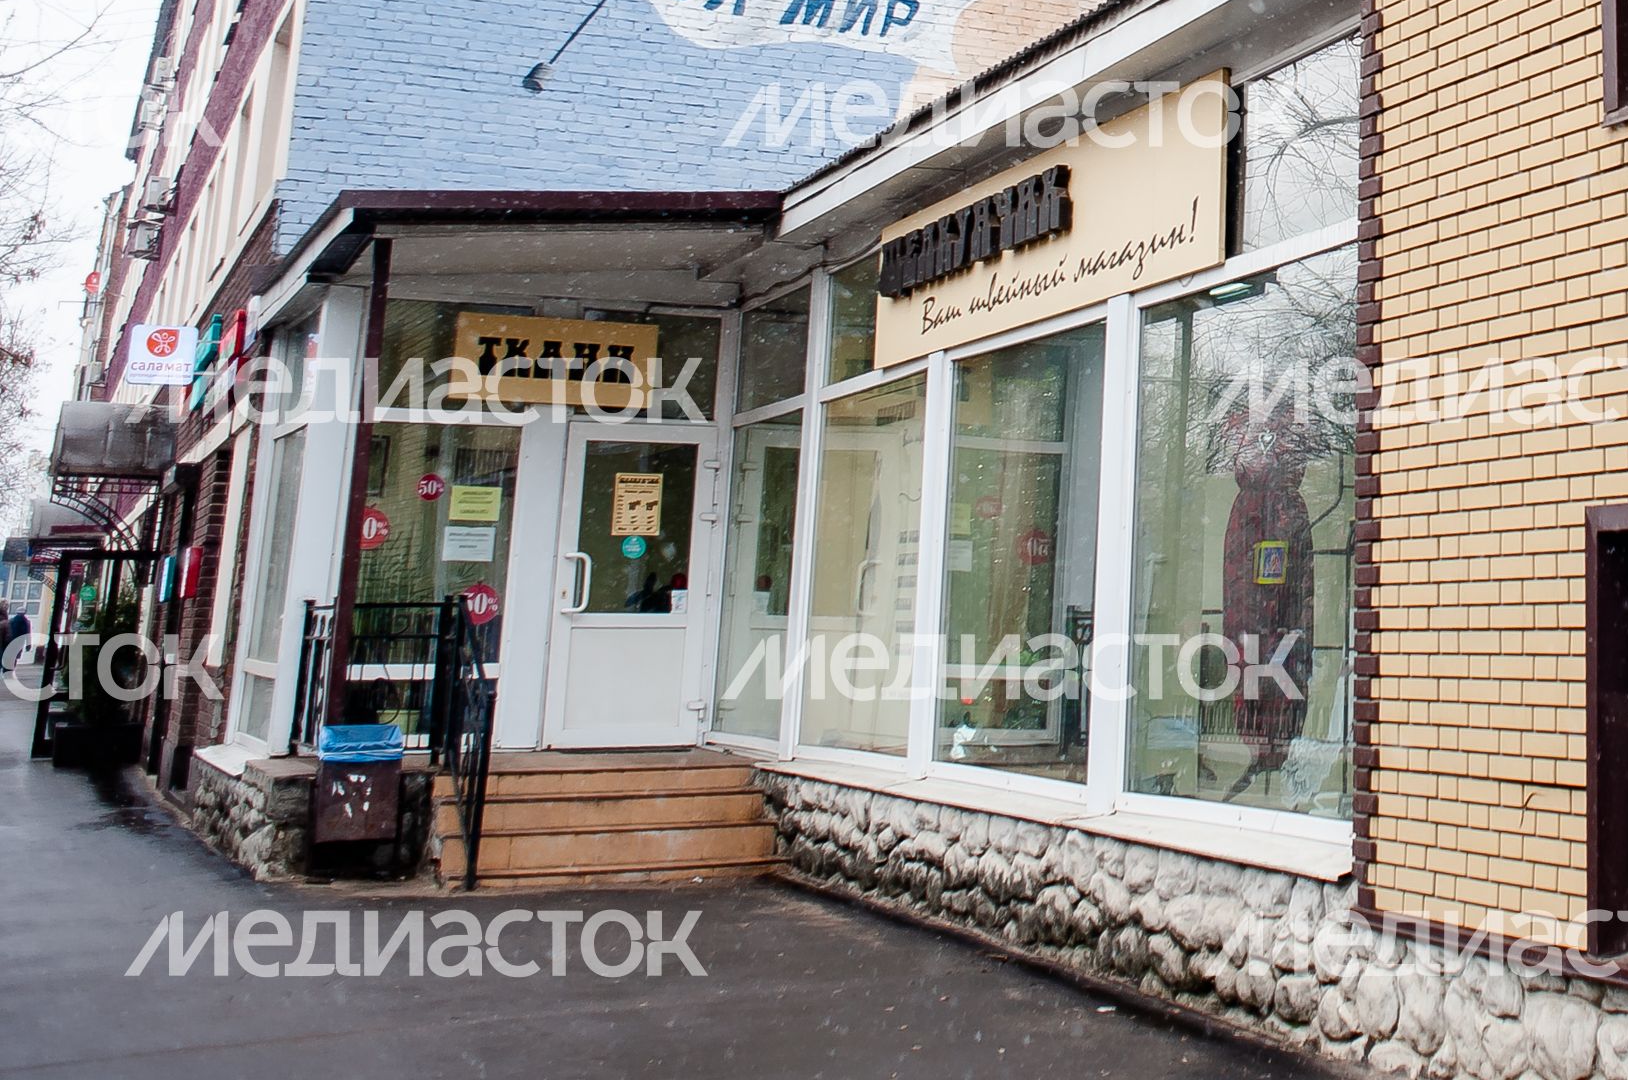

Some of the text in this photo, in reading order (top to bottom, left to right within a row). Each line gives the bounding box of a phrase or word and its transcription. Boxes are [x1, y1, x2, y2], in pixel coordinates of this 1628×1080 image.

[921, 196, 1199, 335] Ваш швейный магазин!
[477, 336, 635, 384] ТКАНИ
[363, 517, 389, 540] 0%
